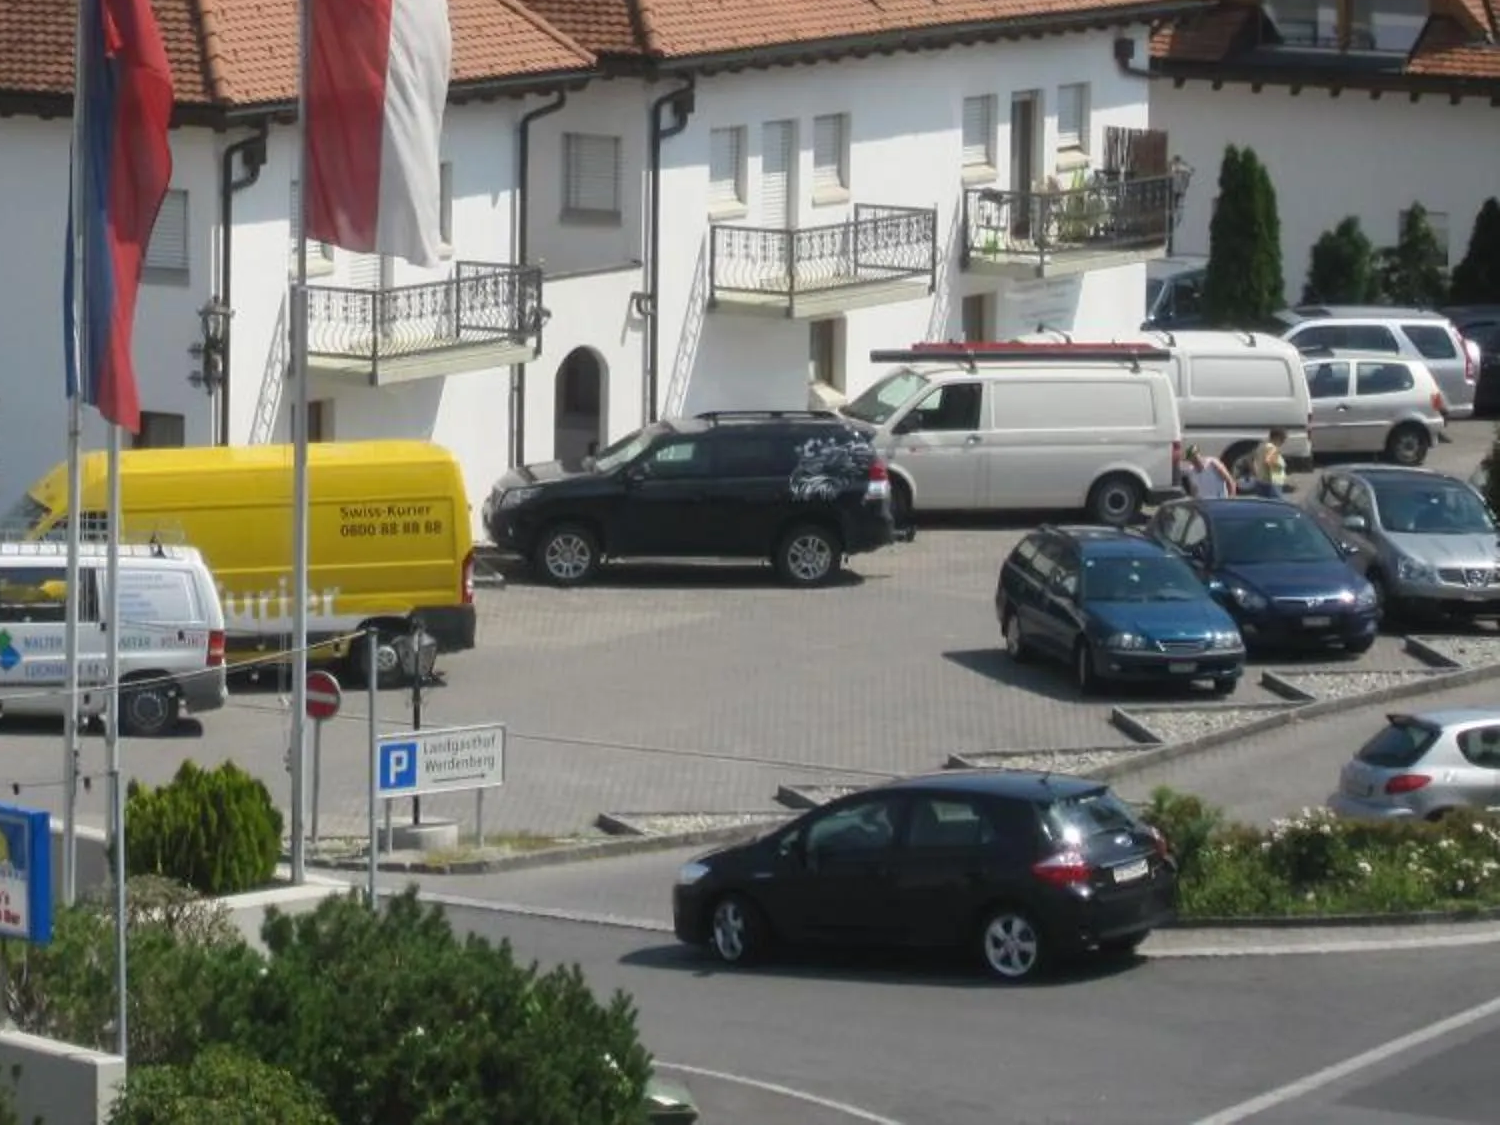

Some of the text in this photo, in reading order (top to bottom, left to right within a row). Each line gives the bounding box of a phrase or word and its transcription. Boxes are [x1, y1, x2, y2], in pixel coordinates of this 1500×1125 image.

[339, 506, 431, 519] Swiss-Kurier
[339, 522, 377, 537] 0800
[381, 521, 398, 536] 88
[422, 733, 497, 756] Landgasthof
[389, 750, 409, 785] P
[423, 756, 496, 774] Werdenberg
